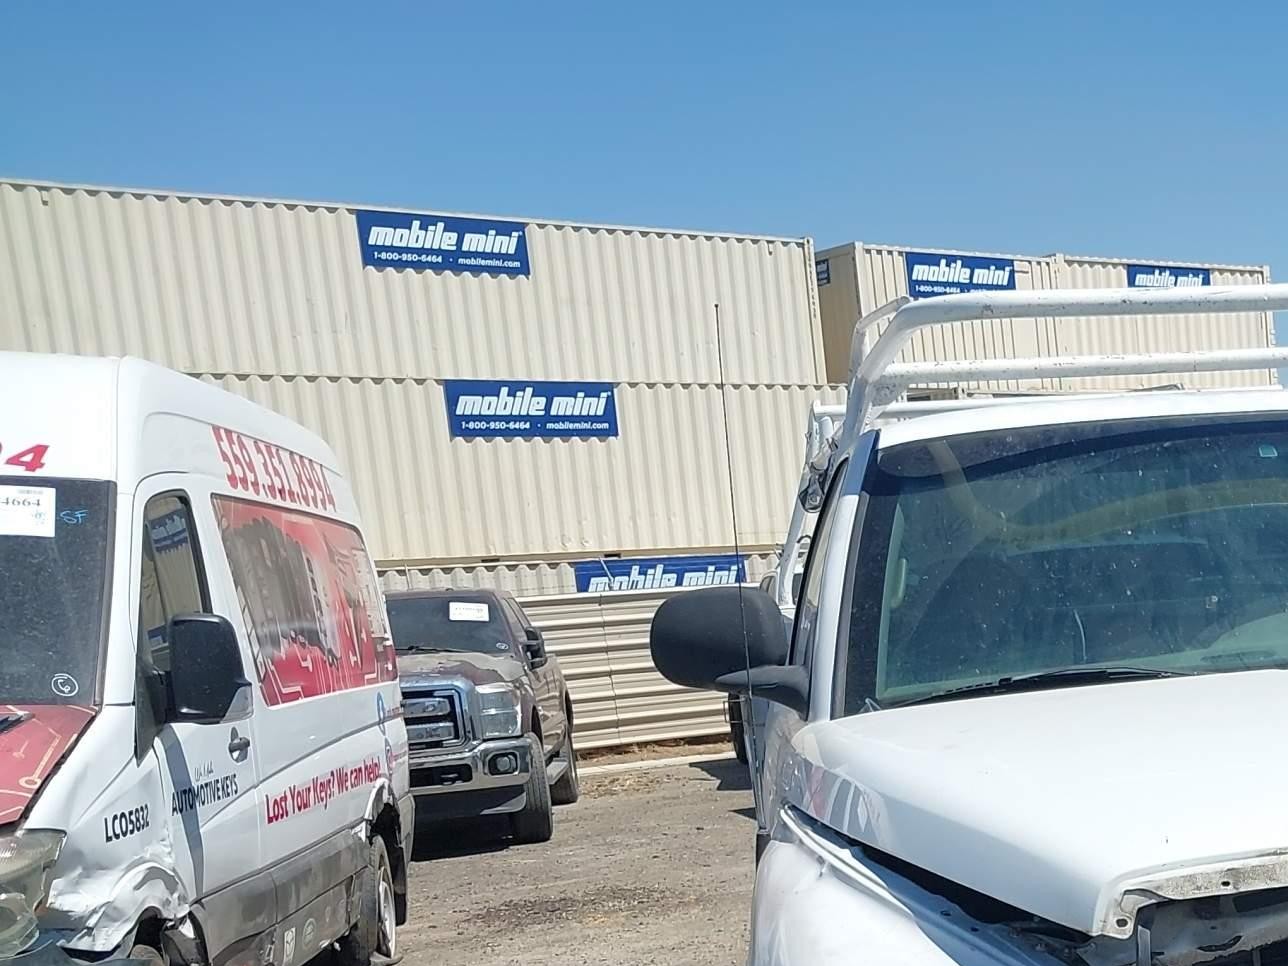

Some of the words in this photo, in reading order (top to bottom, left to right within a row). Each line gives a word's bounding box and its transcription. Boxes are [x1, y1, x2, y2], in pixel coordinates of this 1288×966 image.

[368, 220, 458, 250] mobile
[461, 230, 519, 254] mini
[374, 251, 443, 263] 1-800-950-6464
[458, 257, 521, 268] mobilemini.com
[912, 259, 971, 283] mobile
[973, 265, 1012, 285] mini
[1134, 268, 1176, 288] mobile
[456, 387, 547, 416] mobile
[550, 392, 608, 416] mini
[461, 421, 530, 430] 1-800-950-6464
[546, 421, 610, 430] mobilemini.com
[0, 443, 50, 472] 4
[682, 565, 739, 586] mini
[171, 783, 221, 816] AUTOMOTIVE
[221, 773, 239, 800] KEYS
[265, 790, 289, 824] Lost
[289, 784, 311, 814] Your
[312, 770, 335, 810] Keys?
[336, 765, 349, 795] We
[350, 765, 363, 789] can
